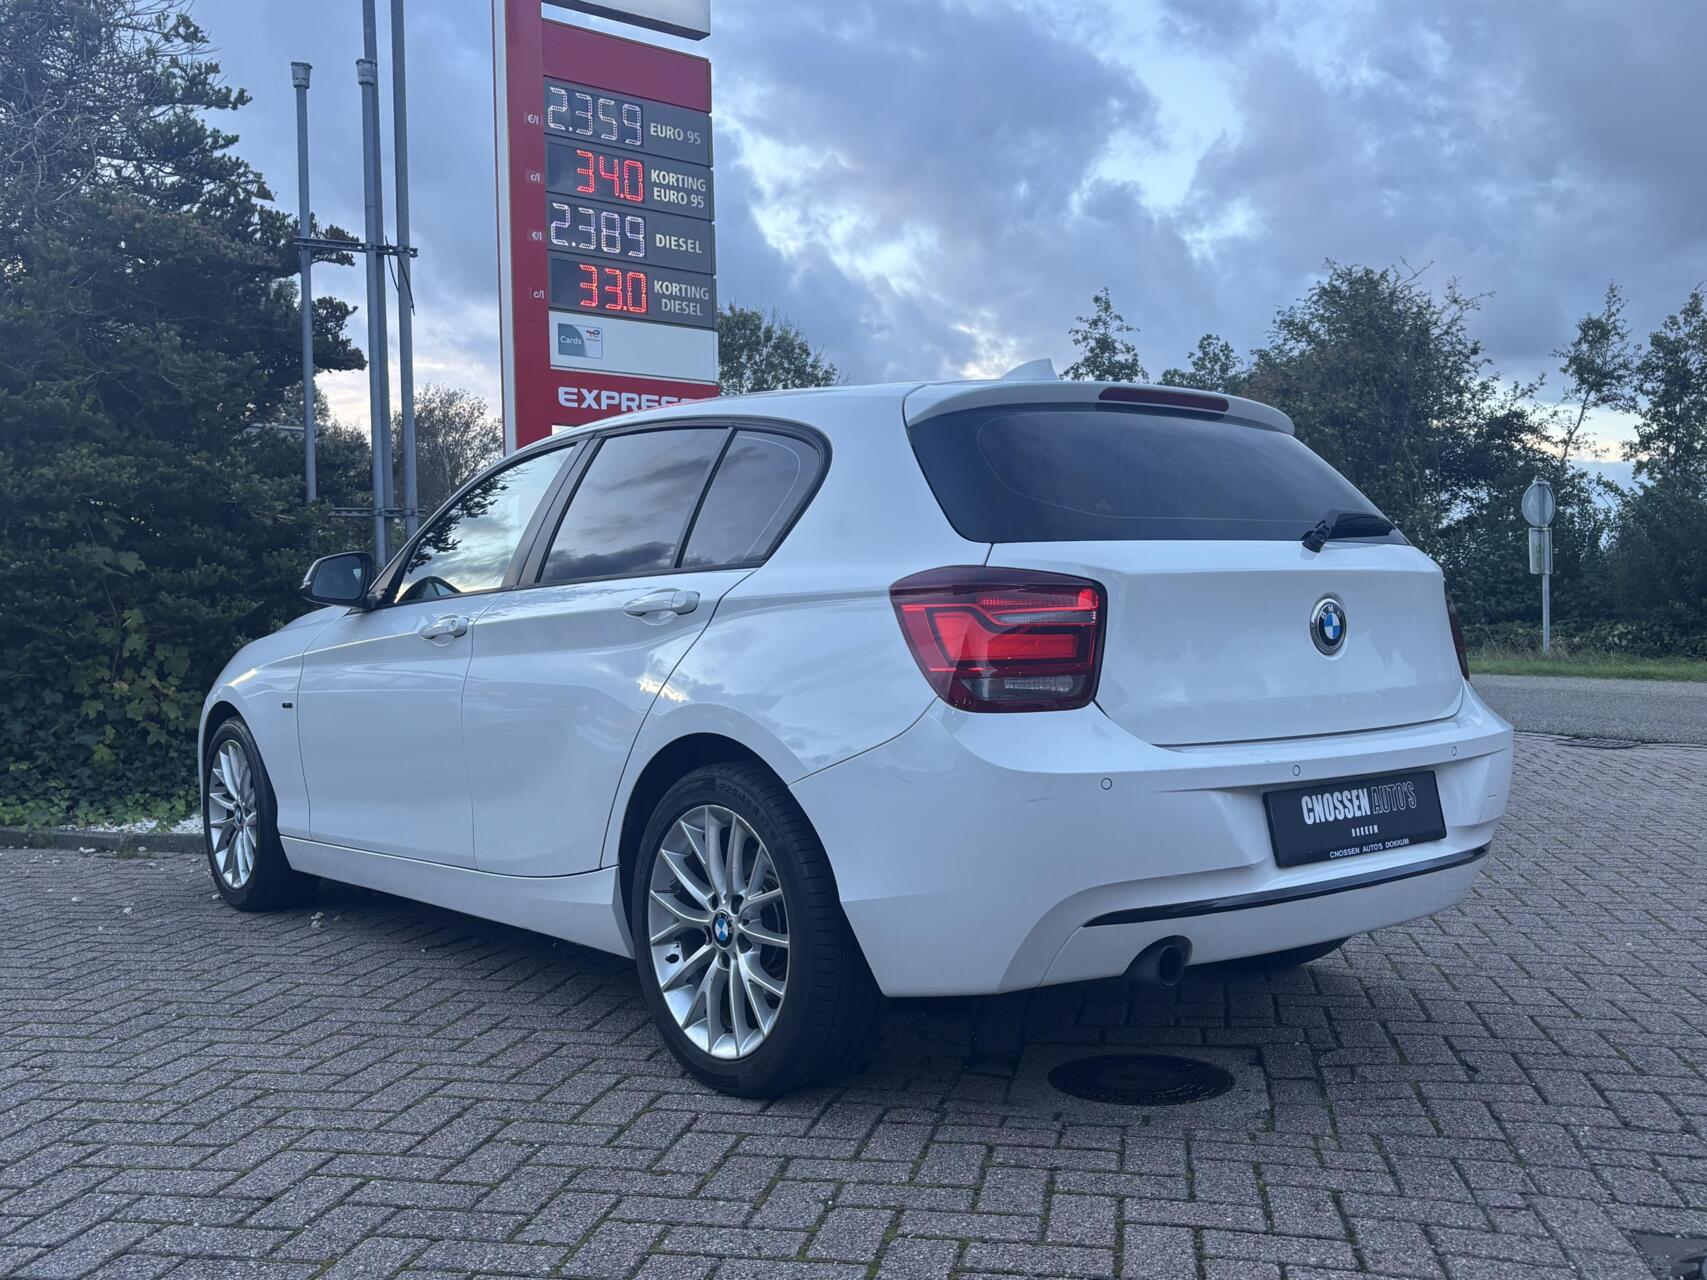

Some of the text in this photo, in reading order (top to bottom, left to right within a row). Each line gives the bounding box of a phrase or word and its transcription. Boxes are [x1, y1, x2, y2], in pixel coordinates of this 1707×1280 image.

[548, 87, 643, 146] 2.359
[650, 122, 701, 145] EURO 95
[576, 149, 645, 202] 34.0
[651, 169, 706, 192] KORTING
[653, 187, 705, 208] EURO 95
[550, 202, 645, 258] 2.389
[655, 233, 703, 254] DIESEL
[579, 264, 647, 313] 33.0
[654, 280, 709, 300] KORTING
[661, 298, 704, 316] DIESEL
[560, 335, 582, 345] Cards
[558, 386, 696, 413] EXPRE
[1301, 781, 1417, 825] CNOSSEN AUTO'S
[1329, 847, 1360, 859] CNOSSEN
